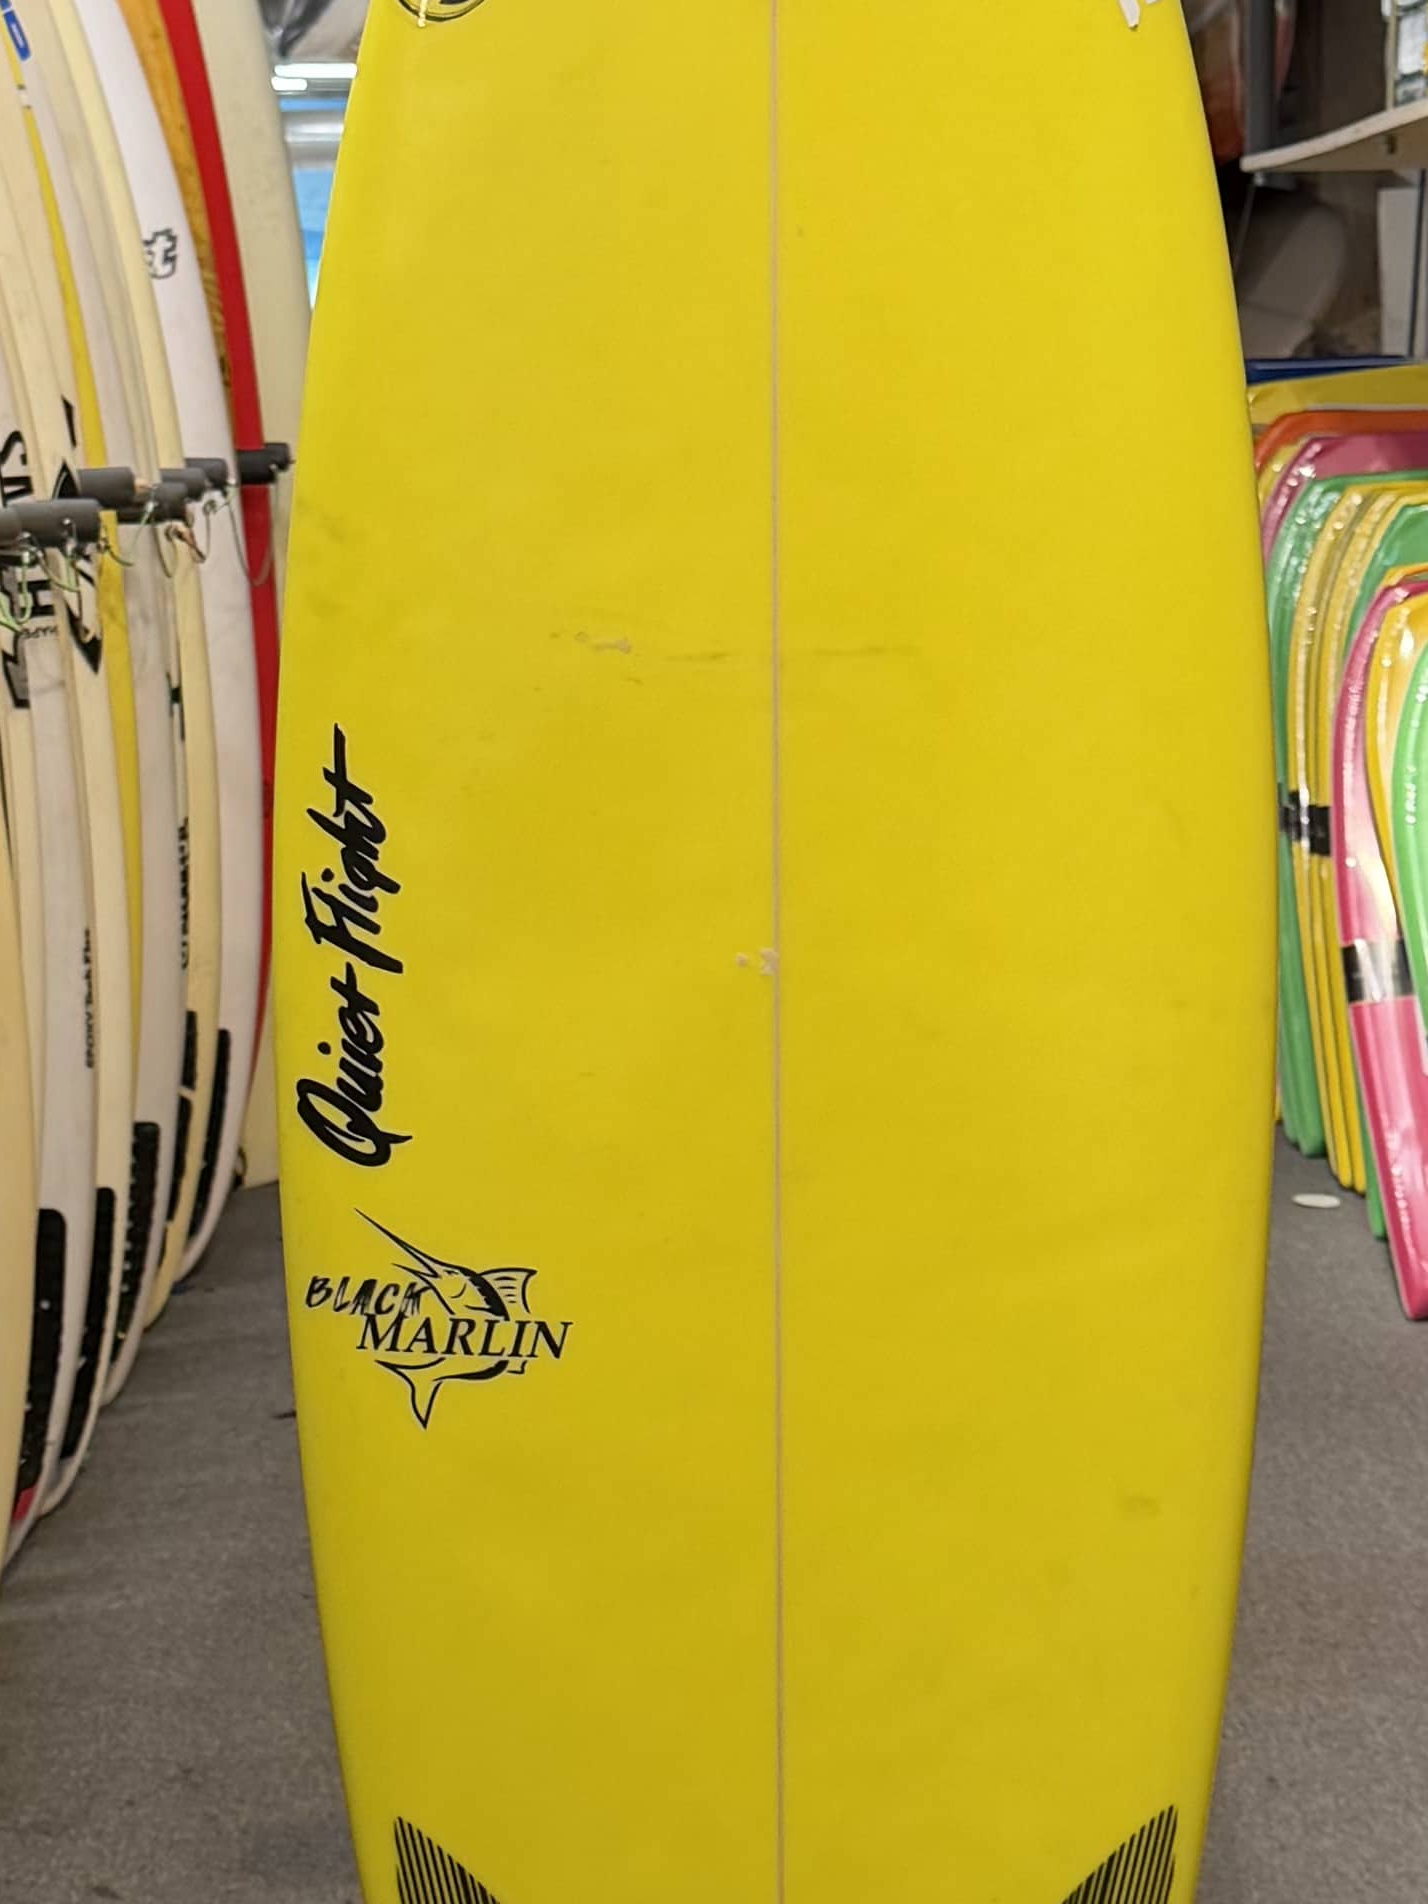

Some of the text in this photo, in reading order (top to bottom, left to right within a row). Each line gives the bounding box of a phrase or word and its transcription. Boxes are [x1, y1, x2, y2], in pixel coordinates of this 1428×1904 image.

[295, 721, 413, 1168] Quiet Flight
[305, 1275, 431, 1317] BLACK
[355, 1310, 574, 1360] MARLIN
